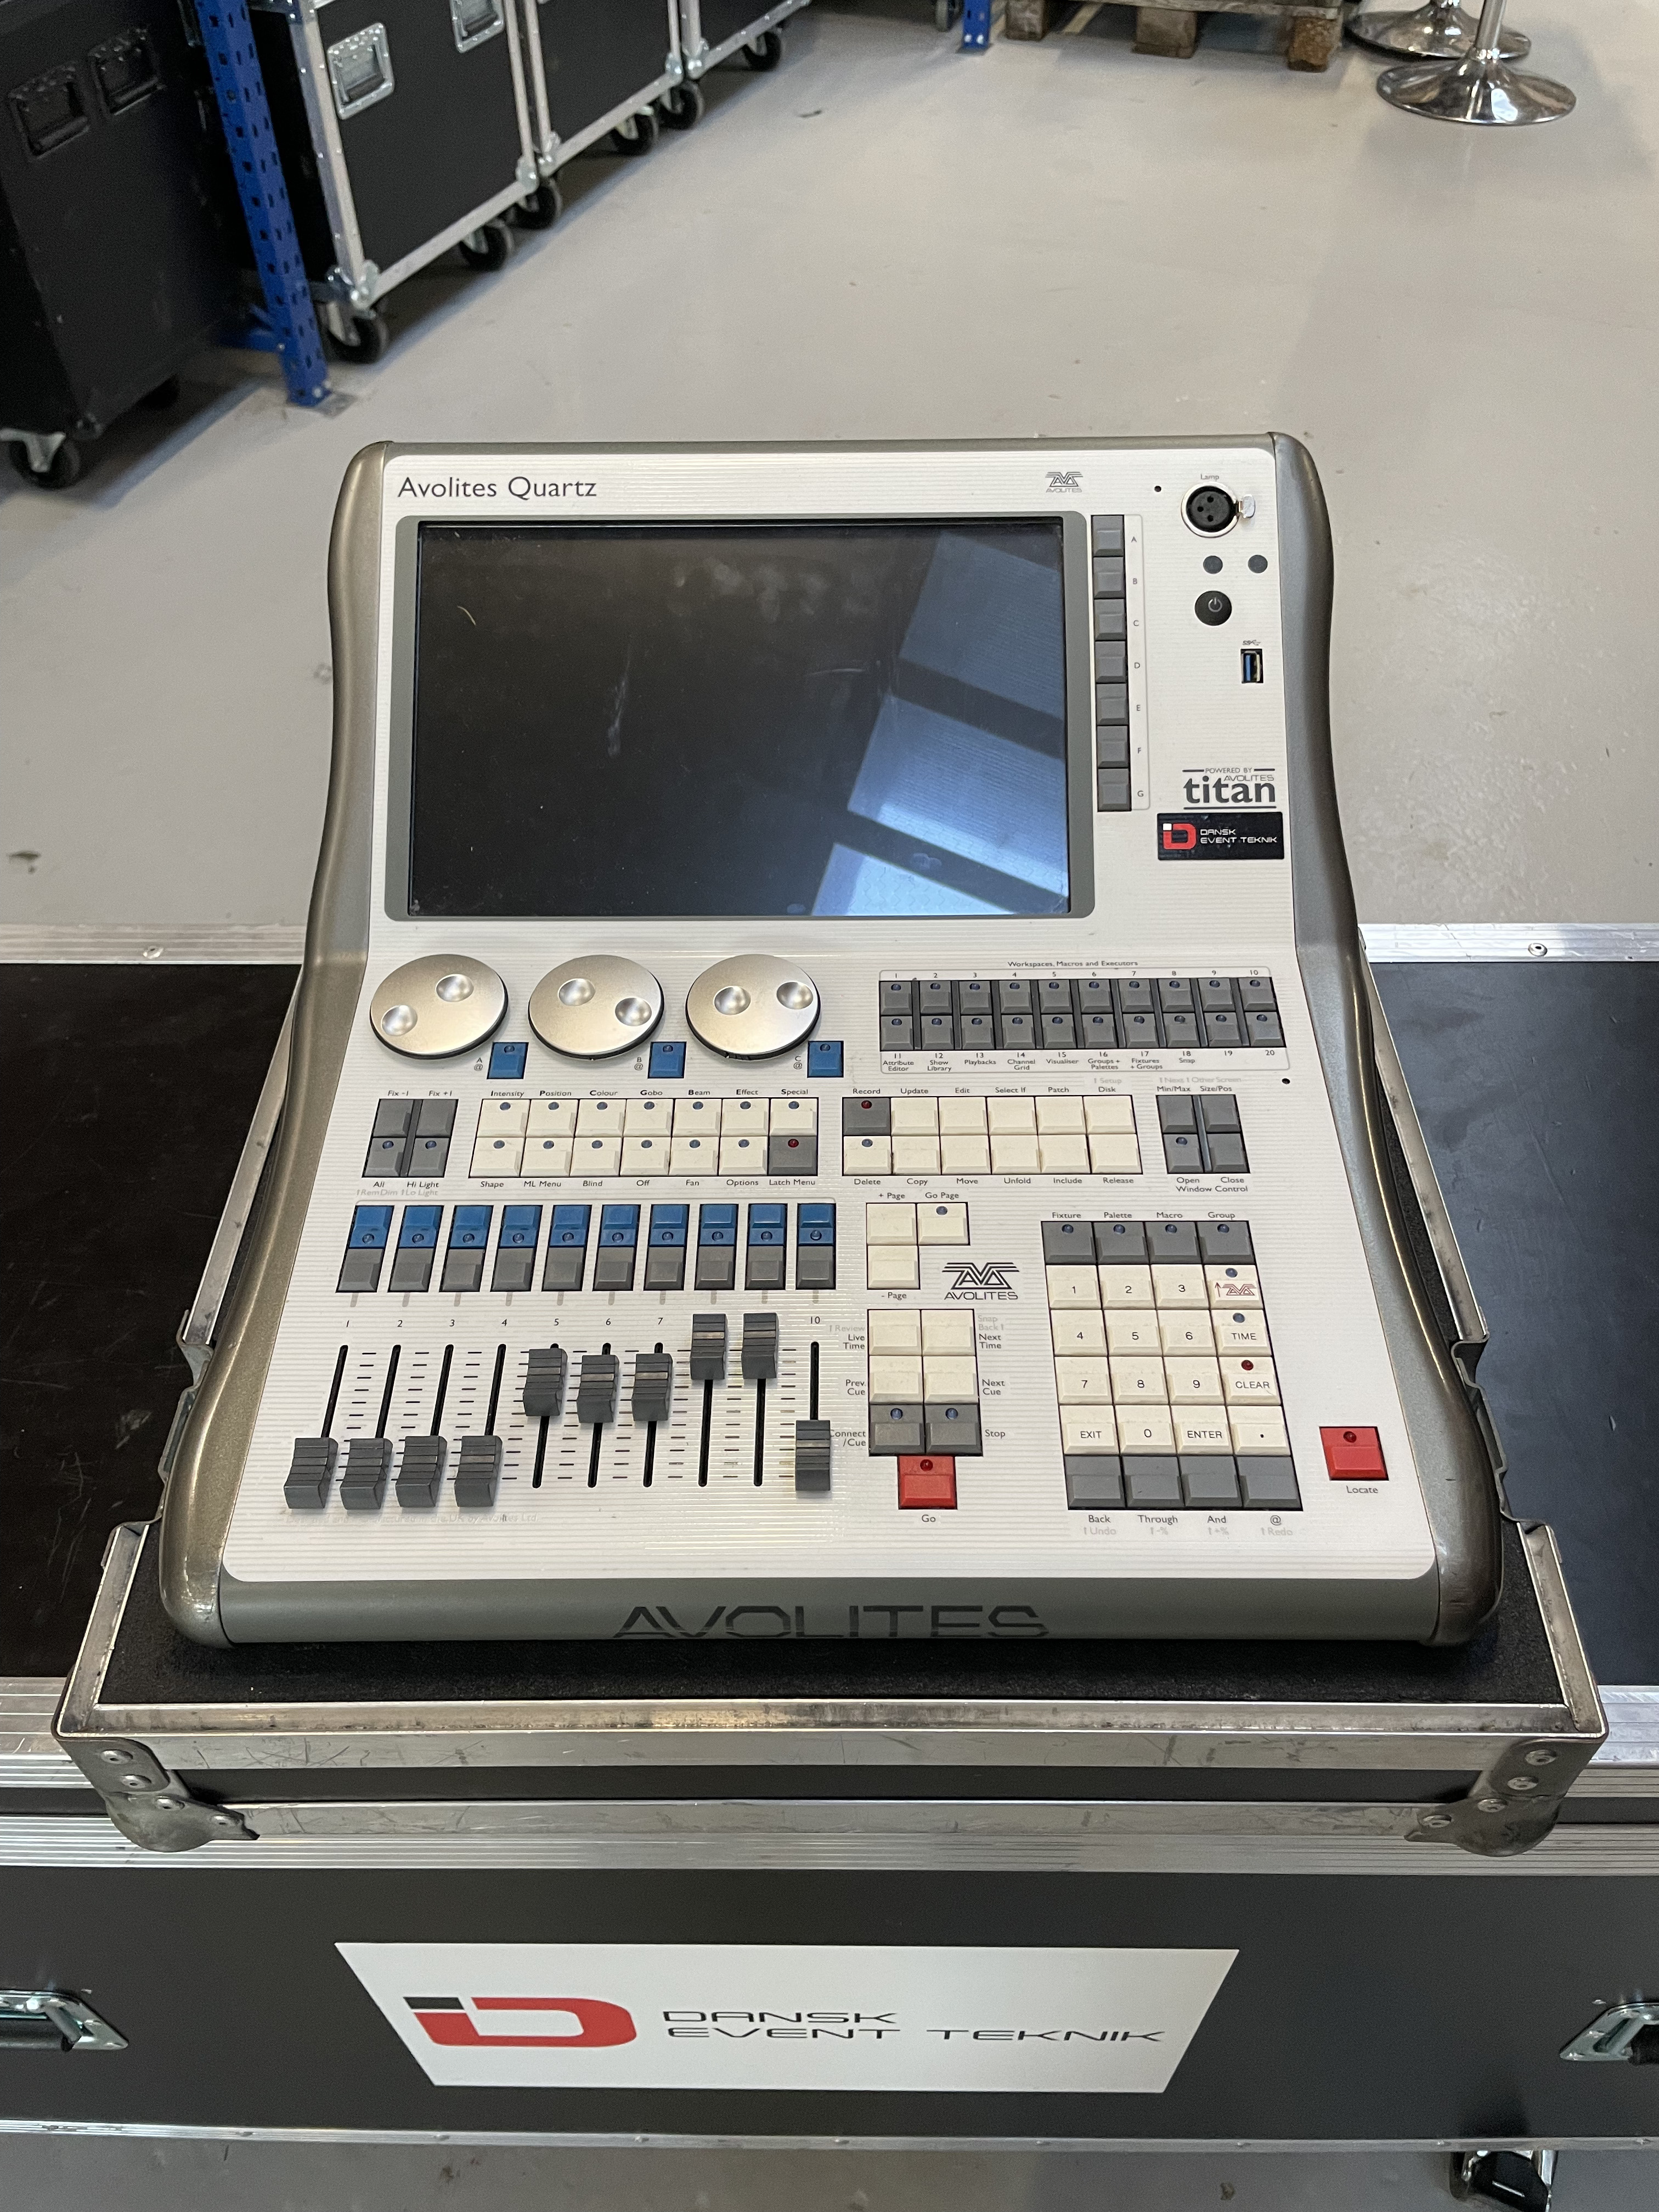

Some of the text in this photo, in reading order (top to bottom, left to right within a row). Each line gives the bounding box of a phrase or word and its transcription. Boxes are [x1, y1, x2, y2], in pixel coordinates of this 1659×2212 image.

[397, 476, 597, 500] Avolites Quartz
[1183, 775, 1276, 803] titan
[490, 1090, 524, 1098] Intensity
[1177, 1177, 1200, 1185] Open
[1178, 1284, 1186, 1293] 3
[1137, 1380, 1144, 1388] 8
[1193, 1380, 1200, 1389] 9
[985, 1430, 1006, 1438] Stop
[1144, 1429, 1152, 1438] 0
[843, 1438, 866, 1447] /Cue
[1137, 1515, 1178, 1524] Through
[1207, 1515, 1226, 1523] And
[1270, 1515, 1282, 1525] @
[612, 1605, 1049, 1639] AVOLITES
[663, 2011, 898, 2024] DANSK
[668, 2027, 1165, 2042] EVENT TEKNIK
